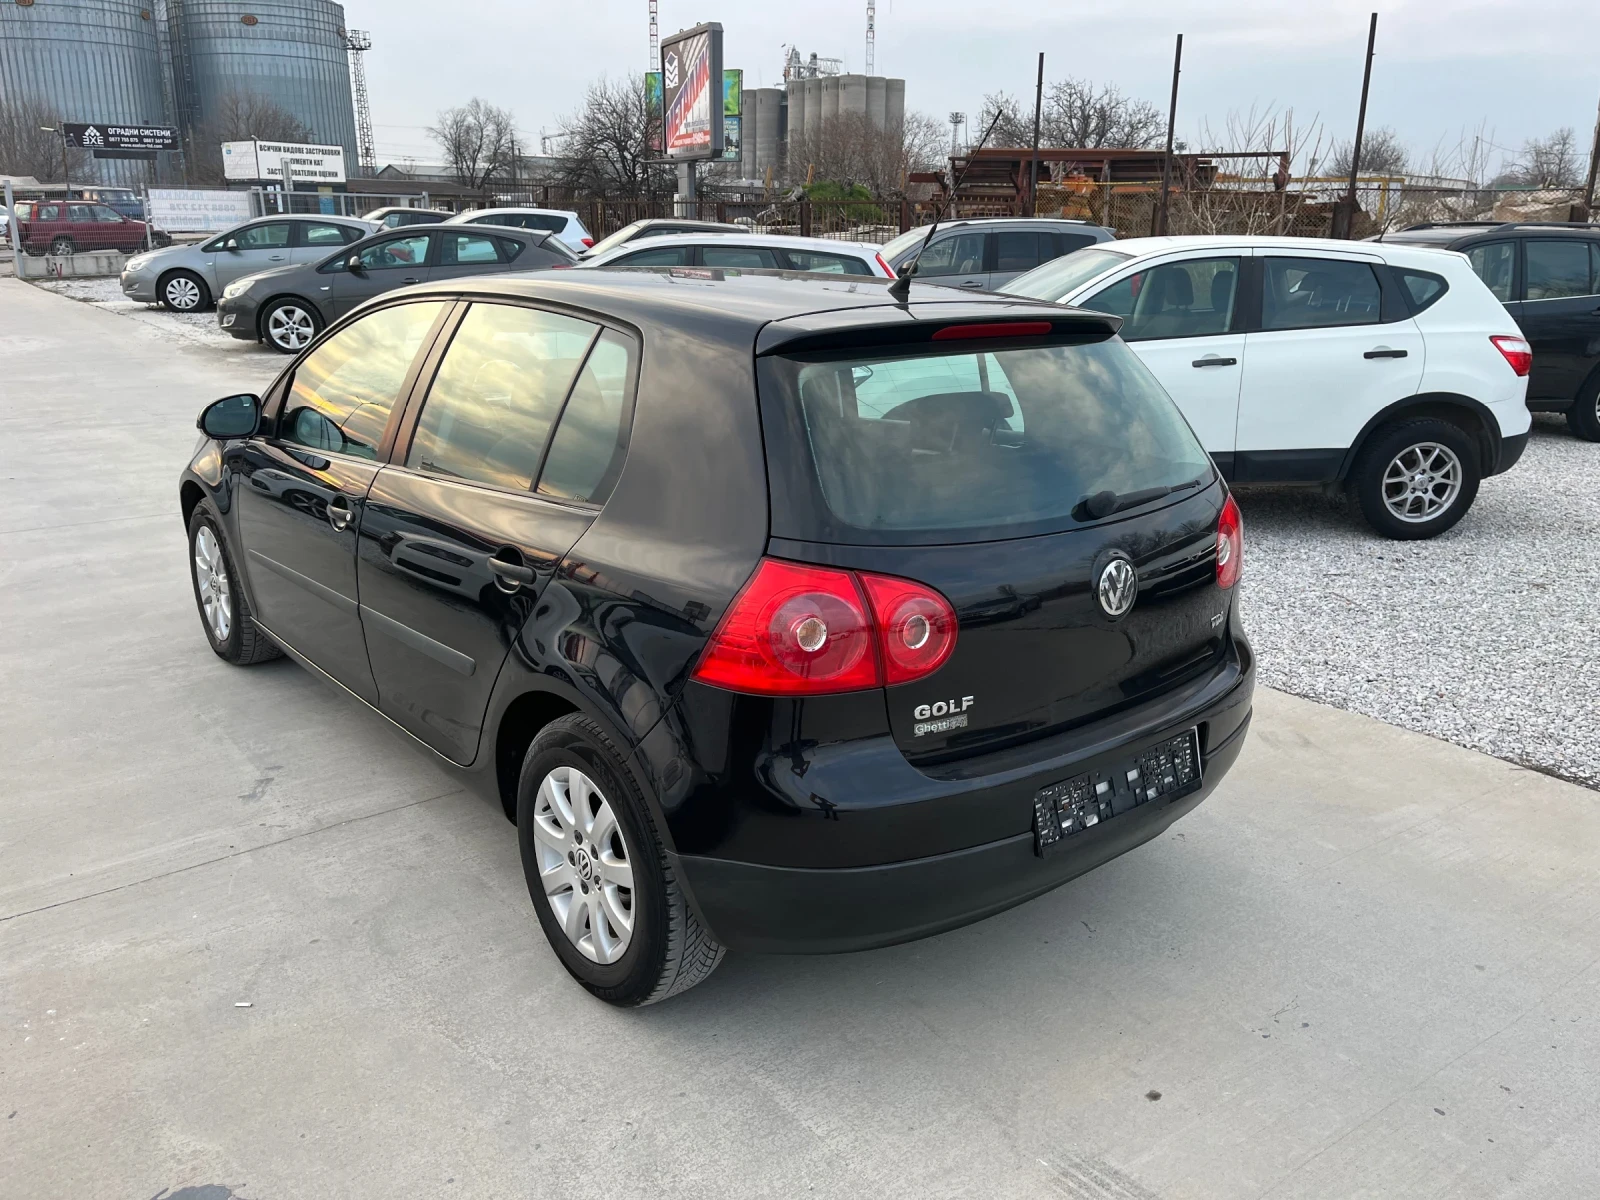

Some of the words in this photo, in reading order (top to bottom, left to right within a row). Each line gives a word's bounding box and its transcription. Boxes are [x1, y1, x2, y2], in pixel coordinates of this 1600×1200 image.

[107, 127, 139, 136] ОГРАДНИ
[139, 128, 171, 137] СИСТЕМИ
[259, 144, 282, 153] ВСИЧКИ
[282, 146, 305, 155] ВИДОВЕ
[305, 147, 341, 156] ЗАСТРАХОВКИ
[318, 170, 338, 178] ОЦЕНКИ
[914, 695, 974, 720] GOLF
